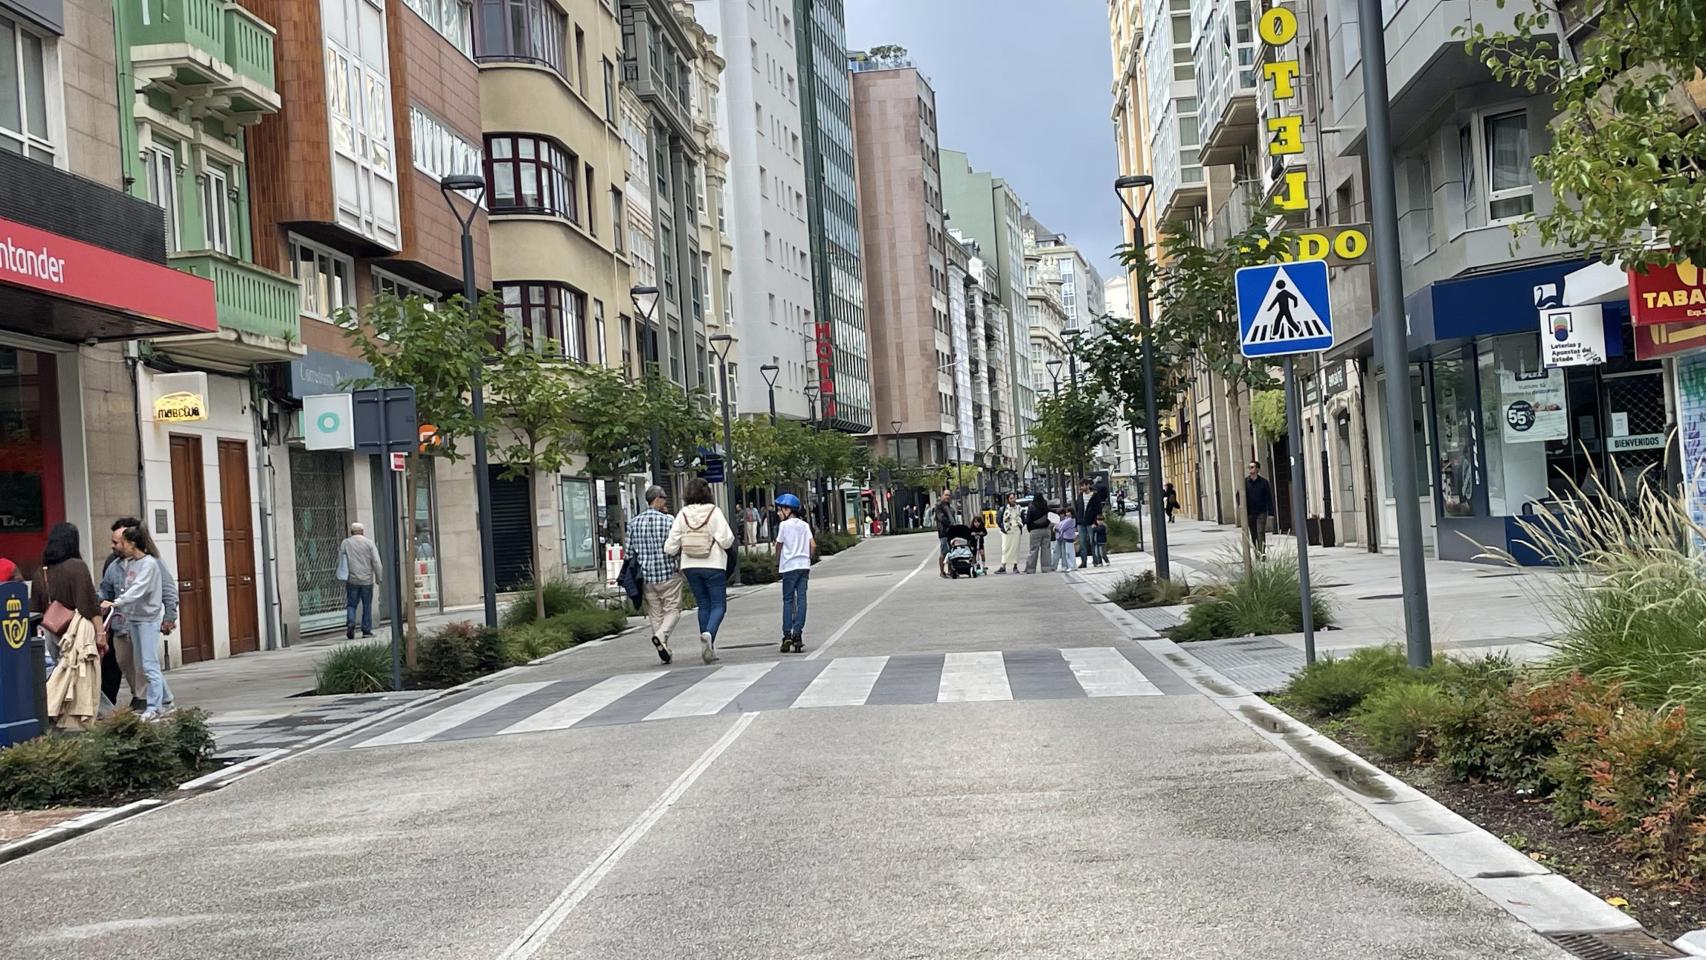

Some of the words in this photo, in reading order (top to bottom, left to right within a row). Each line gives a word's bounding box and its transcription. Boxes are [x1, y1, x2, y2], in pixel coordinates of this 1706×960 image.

[1642, 288, 1706, 309] TABA
[1552, 349, 1580, 357] Apuestas
[1552, 355, 1578, 363] Estado
[816, 320, 836, 417] HOTEL
[1614, 437, 1660, 449] BIENVENIDOS
